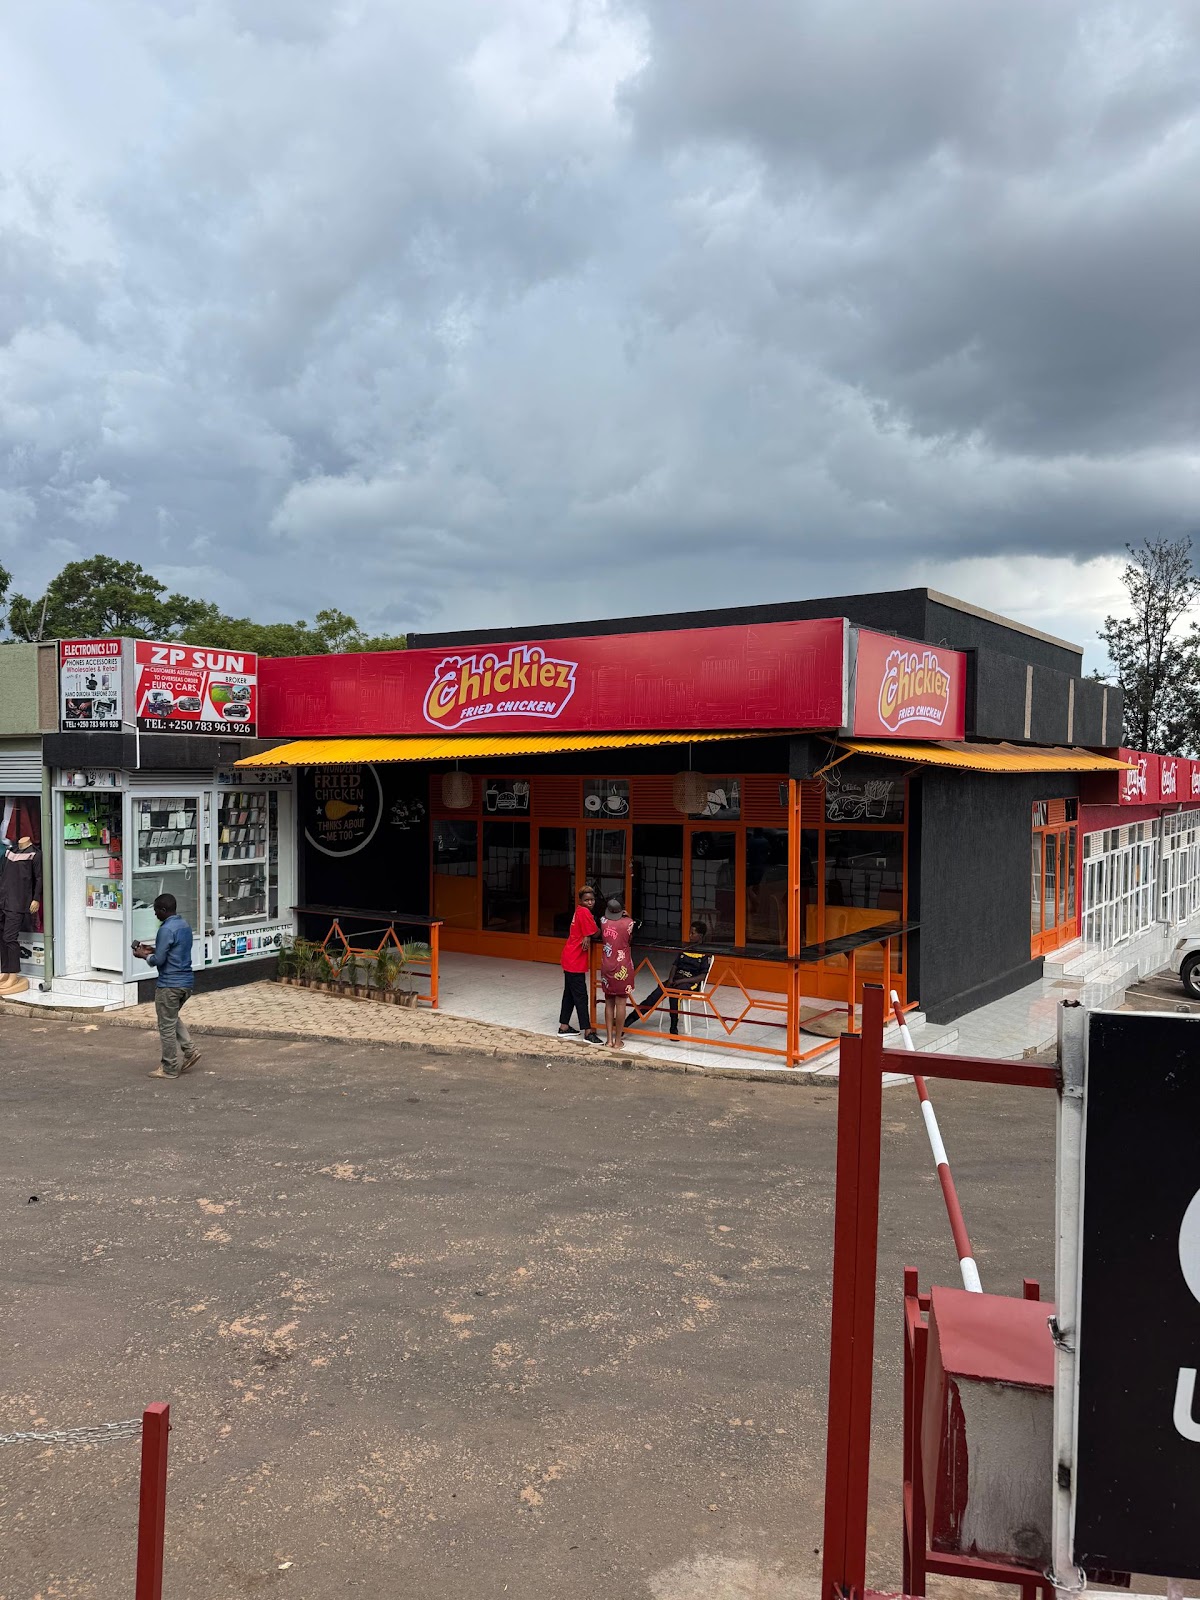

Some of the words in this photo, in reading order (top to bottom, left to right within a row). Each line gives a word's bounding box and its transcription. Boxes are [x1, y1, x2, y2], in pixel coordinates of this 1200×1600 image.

[64, 643, 106, 656] ELECTRONICS
[106, 642, 119, 655] LTD
[85, 658, 118, 666] ACCESSORIES
[150, 646, 186, 666] ZP
[192, 651, 245, 673] SUN
[149, 667, 176, 676] CUSTOMERS
[176, 669, 202, 678] ASSISTANCE
[161, 675, 184, 683] OVERSEAS
[151, 681, 174, 690] EURO
[174, 683, 197, 692] CARS
[225, 676, 247, 684] BROKER
[428, 651, 570, 719] Chickiez
[881, 657, 948, 719] Chickiez
[460, 703, 494, 719] FRIED
[496, 700, 557, 713] CHICKEN
[898, 706, 916, 721] FRIED
[916, 705, 943, 721] CHICKEN
[65, 720, 77, 729] TEL:
[77, 720, 89, 729] +250
[109, 720, 119, 728] 926
[144, 718, 167, 729] TEL:
[168, 719, 193, 731] +250
[194, 721, 215, 731] 783
[214, 722, 234, 732] 961
[233, 723, 251, 734] 926
[314, 774, 361, 788] FRIED
[314, 788, 364, 801] CHICKEN
[316, 820, 342, 832] THINKS
[343, 818, 366, 829] ABOUT
[326, 831, 338, 842] ME
[338, 830, 354, 840] TOO
